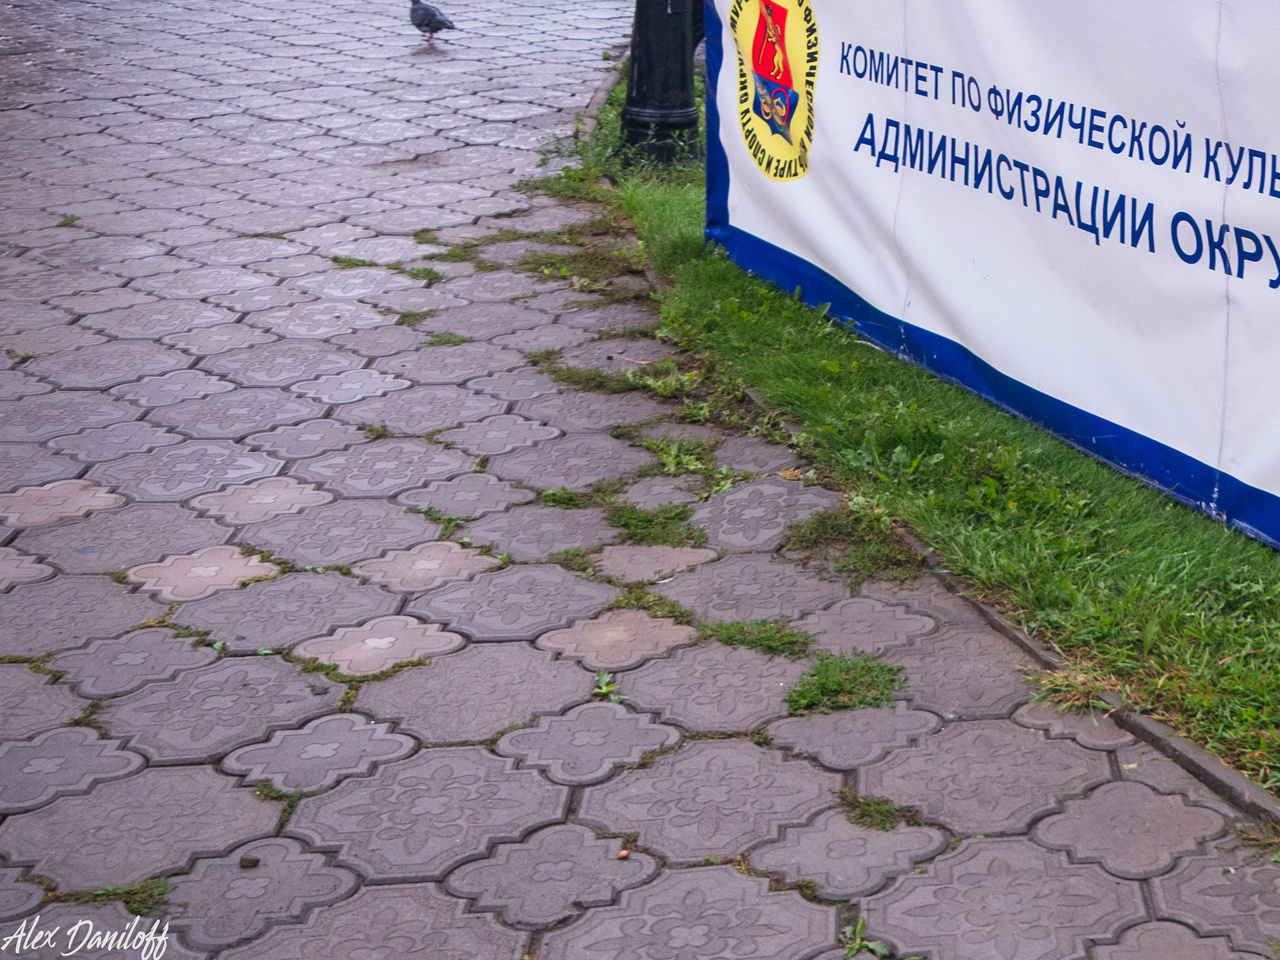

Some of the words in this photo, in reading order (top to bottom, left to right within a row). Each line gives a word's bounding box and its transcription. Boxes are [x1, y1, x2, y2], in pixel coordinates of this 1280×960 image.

[735, 37, 750, 104] ОКРУ
[740, 109, 766, 168] СПОРТУ
[839, 42, 945, 100] КОМИТЕТ
[952, 69, 983, 112] ПО
[987, 85, 1194, 173] ФИЗИЧЕСКОЙ
[773, 137, 809, 179] КЬТУРЕ
[852, 113, 1156, 253] АДМИНИСТРАЦИИ
